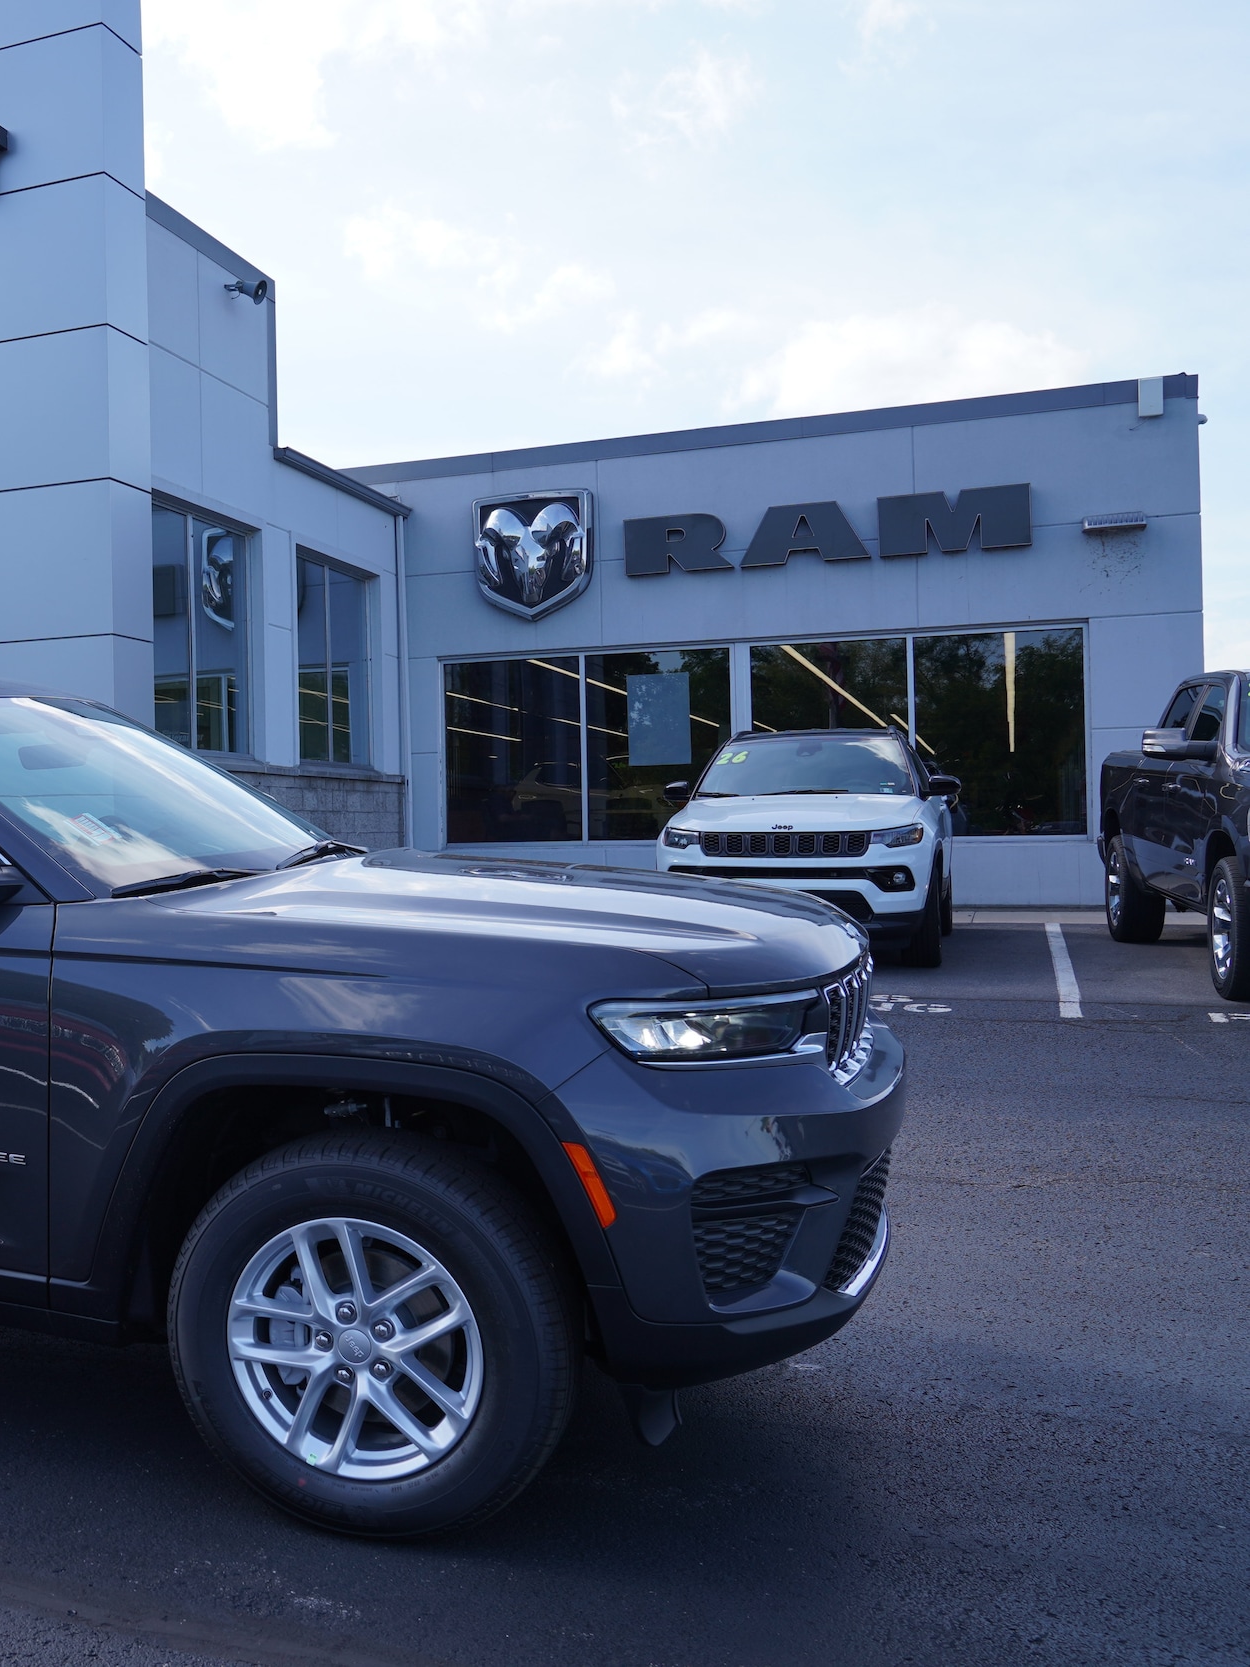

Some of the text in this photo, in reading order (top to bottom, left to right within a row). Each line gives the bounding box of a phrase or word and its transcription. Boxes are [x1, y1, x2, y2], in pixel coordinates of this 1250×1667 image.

[623, 482, 1033, 577] RAM
[715, 749, 750, 766] 26
[771, 823, 794, 831] Jeep
[353, 1182, 455, 1235] MICHELIN
[344, 1335, 365, 1358] Jeep
